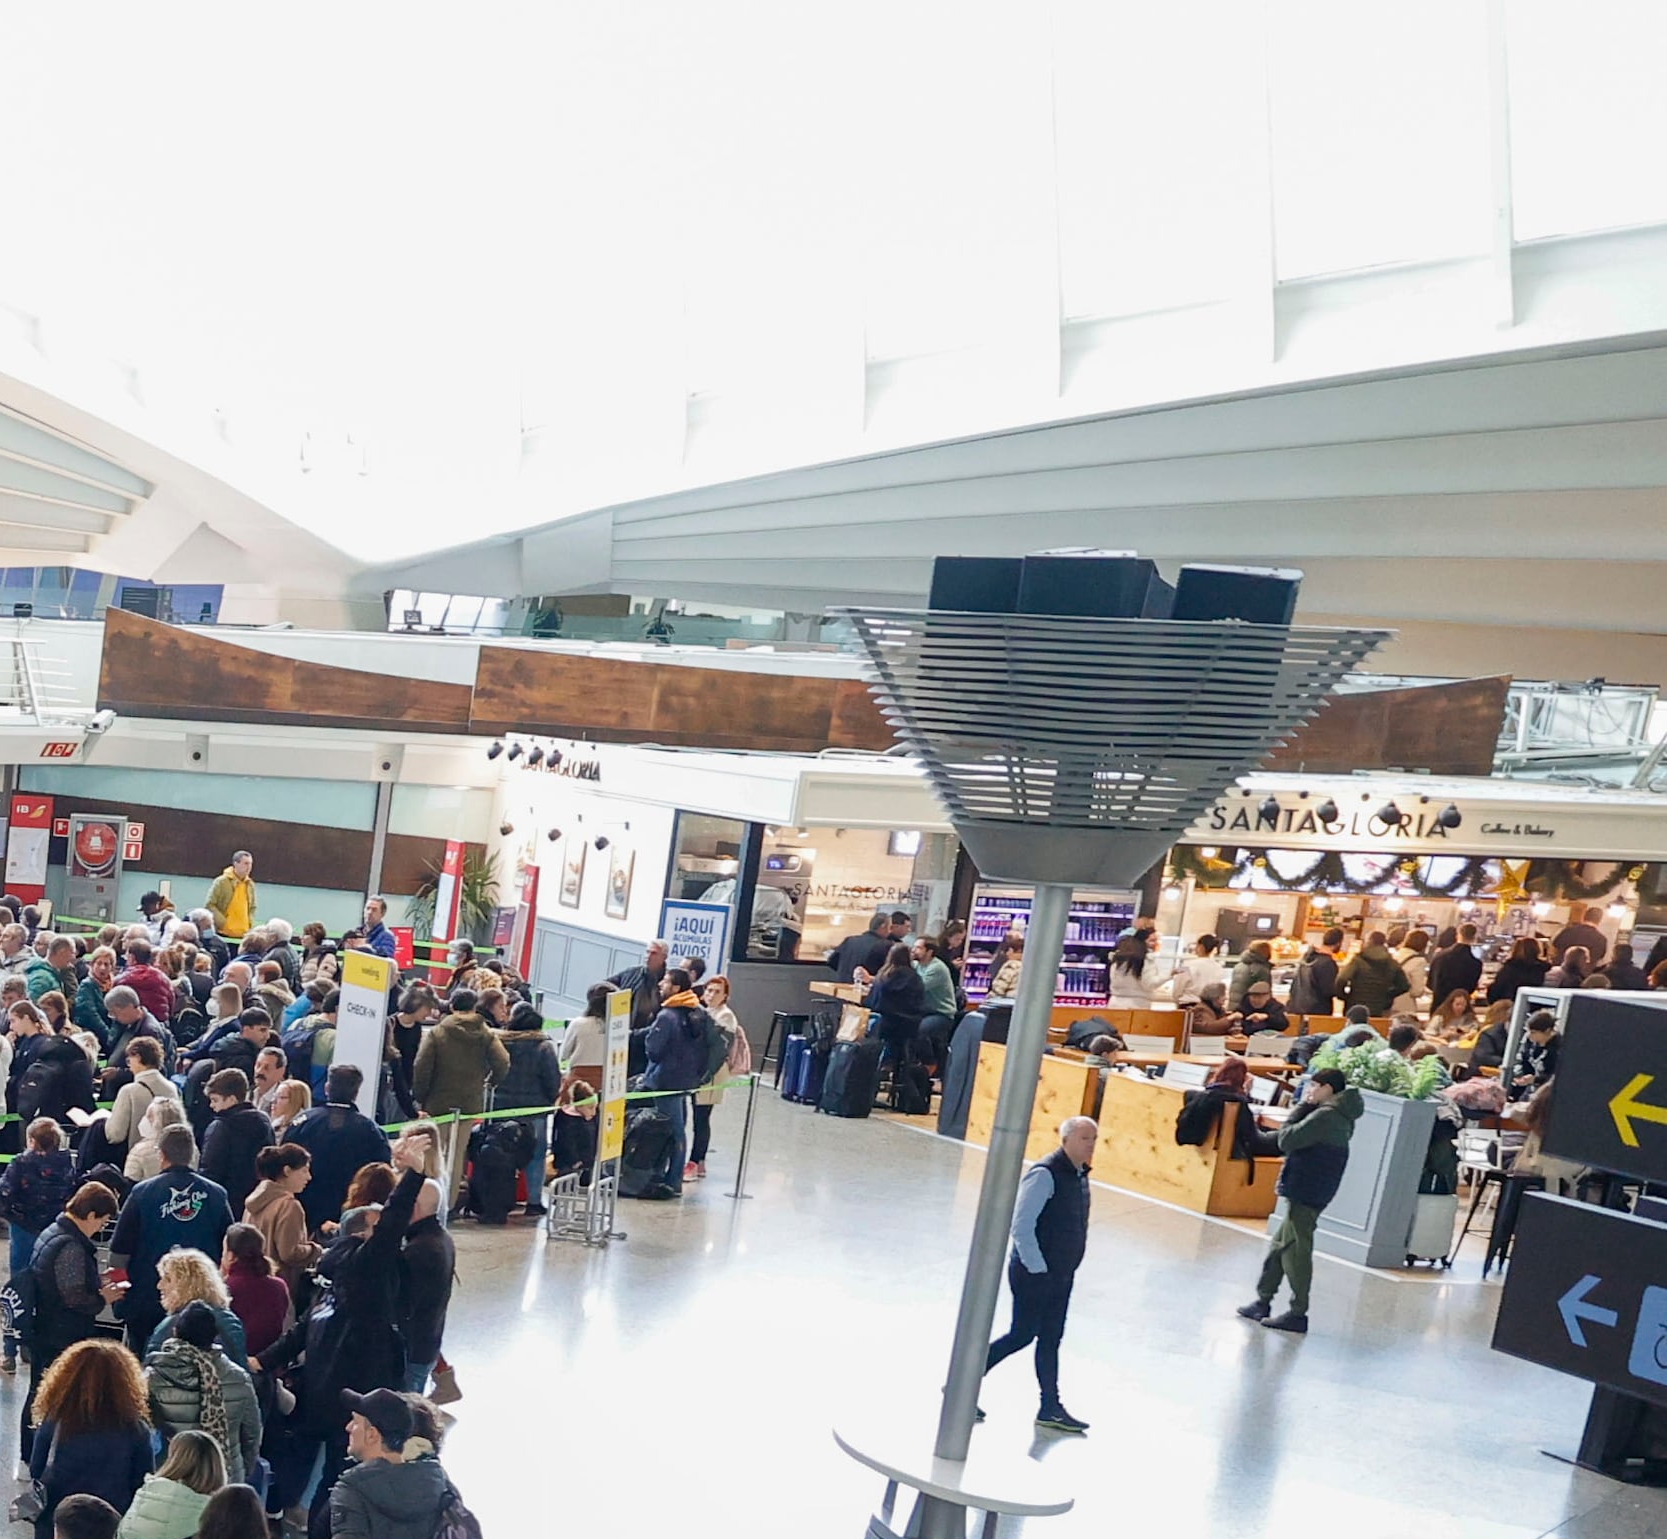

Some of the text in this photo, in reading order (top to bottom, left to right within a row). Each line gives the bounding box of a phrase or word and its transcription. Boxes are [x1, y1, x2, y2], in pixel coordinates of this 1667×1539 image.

[16, 805, 29, 814] IB
[1513, 824, 1522, 836] &
[674, 916, 715, 935] ¡AQUÍ
[673, 934, 712, 945] ACUMULAS
[346, 1002, 377, 1019] CHECK-IN
